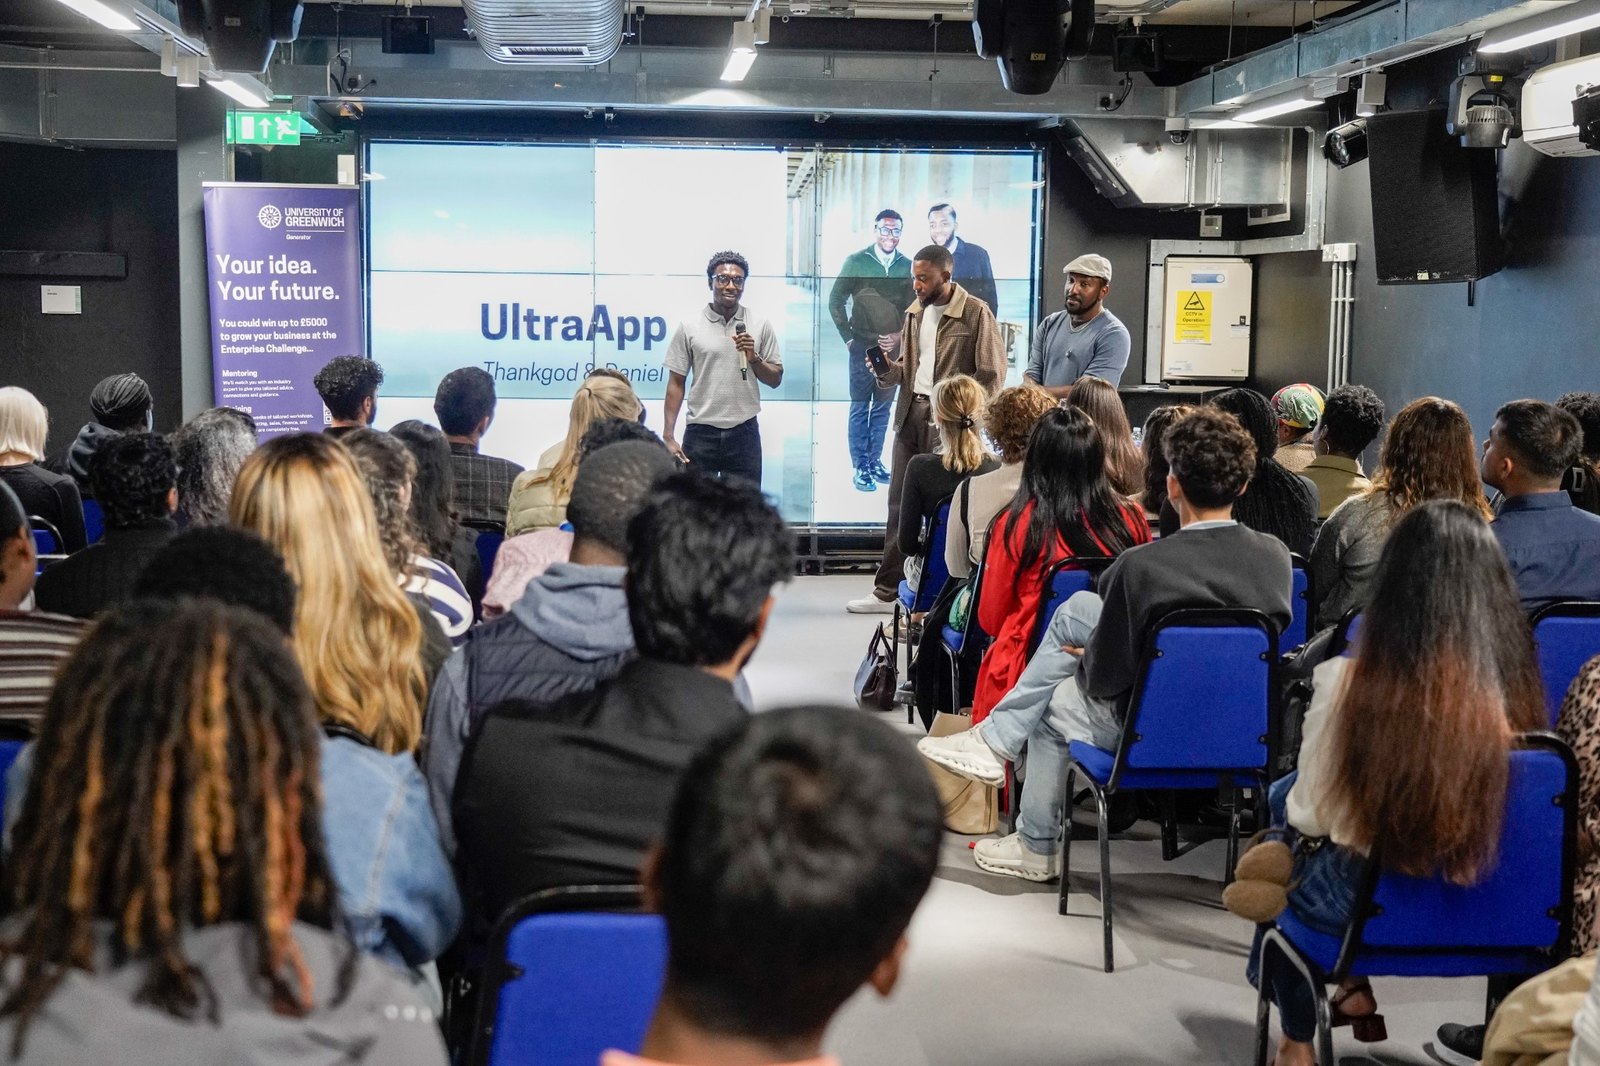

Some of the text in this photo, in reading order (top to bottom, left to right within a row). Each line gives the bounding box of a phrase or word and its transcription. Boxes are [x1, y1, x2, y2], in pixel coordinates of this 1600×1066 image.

[285, 208, 332, 216] UNIVERSITY
[285, 217, 344, 226] GREENWICH
[216, 254, 317, 274] Your idea.
[218, 280, 339, 300] Your future.
[219, 318, 236, 327] You
[238, 318, 260, 327] could
[262, 318, 276, 327] win
[278, 320, 288, 328] up
[300, 318, 327, 326] £5000
[481, 303, 667, 350] UltraApp
[231, 333, 252, 342] grow
[254, 333, 272, 341] your
[274, 331, 310, 340] business
[322, 331, 336, 339] the
[221, 344, 314, 355] Enterprise Challenge...
[484, 361, 578, 386] Thankgod
